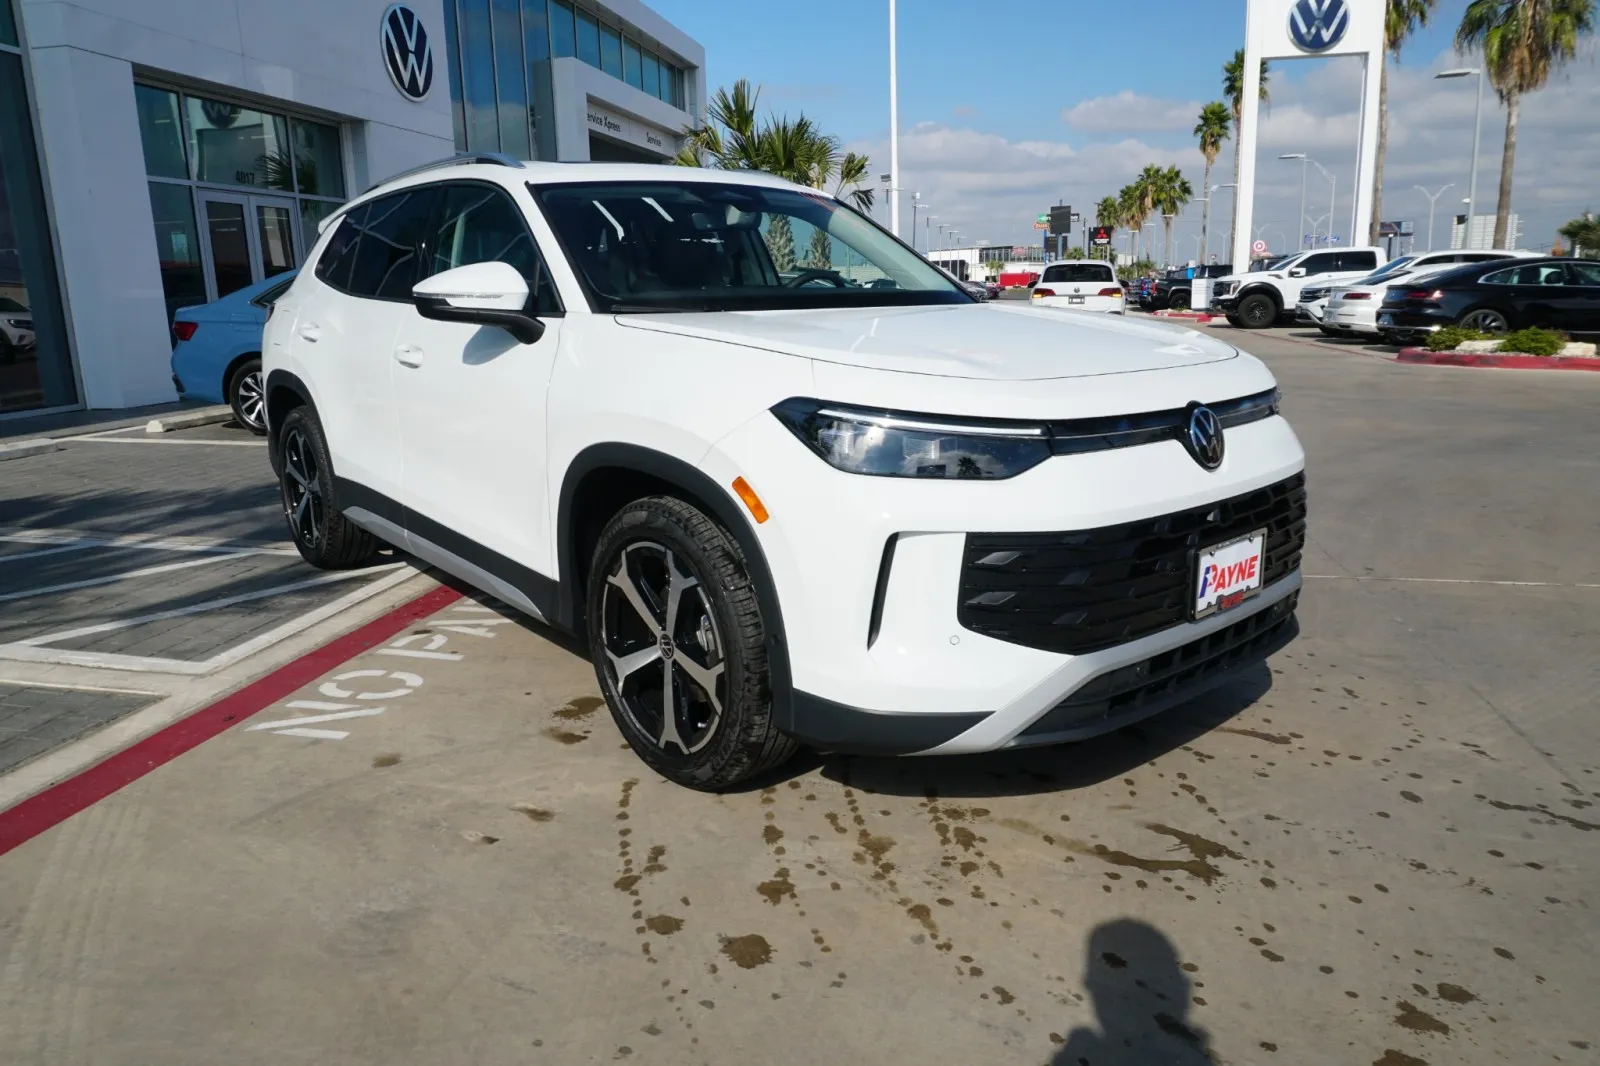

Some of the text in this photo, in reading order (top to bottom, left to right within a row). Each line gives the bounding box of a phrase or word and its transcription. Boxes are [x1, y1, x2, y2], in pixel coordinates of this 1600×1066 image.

[1289, 0, 1349, 50] VW
[382, 4, 432, 100] VW
[587, 112, 603, 126] ervice
[646, 132, 662, 147] Service
[1199, 554, 1258, 599] PAYNE
